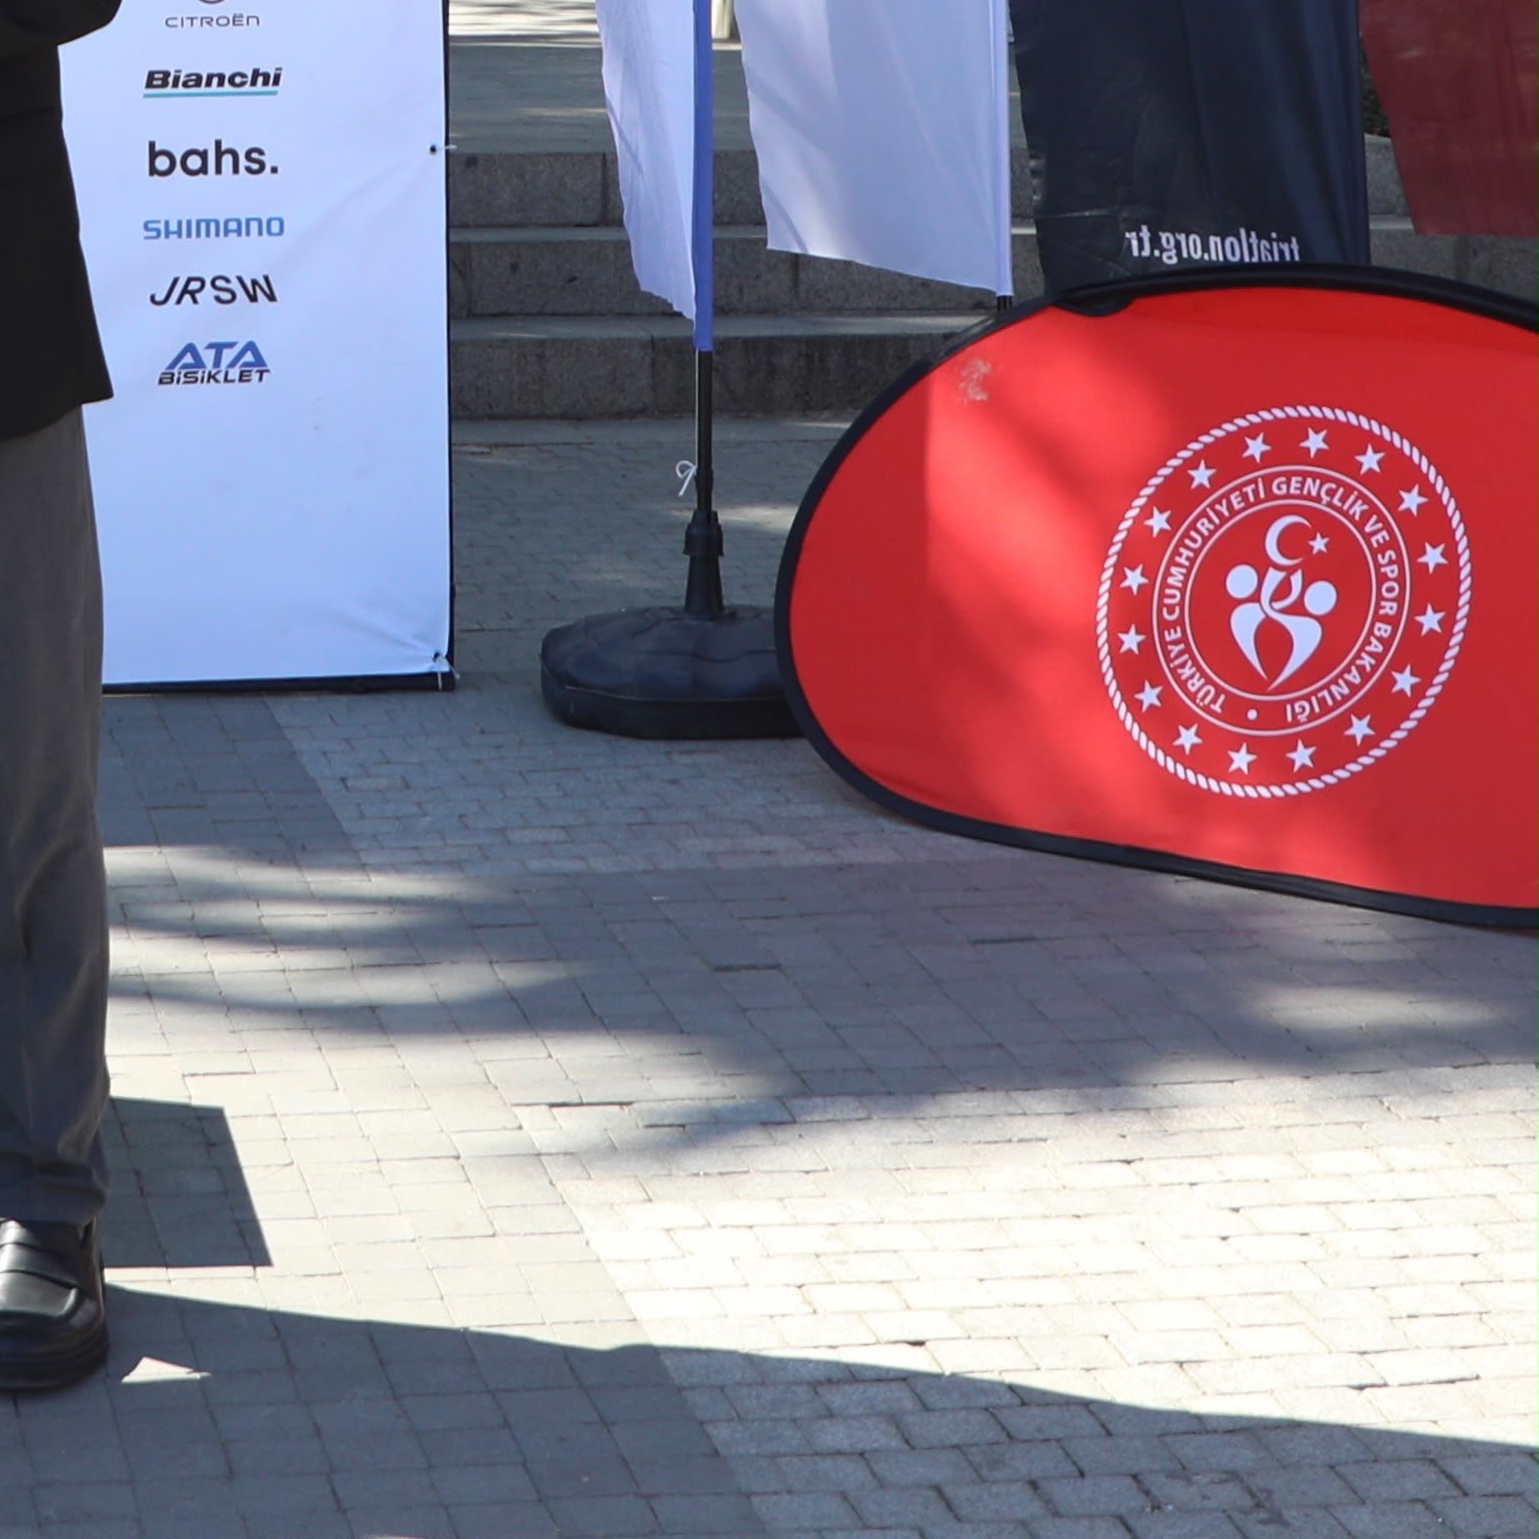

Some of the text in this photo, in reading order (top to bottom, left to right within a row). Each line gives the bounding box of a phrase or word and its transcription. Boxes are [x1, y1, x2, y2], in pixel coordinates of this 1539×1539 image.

[145, 67, 282, 90] Bianchi
[148, 140, 279, 177] bahs.
[143, 217, 285, 241] SHIMANO
[164, 340, 269, 369] ATA
[1162, 476, 1400, 723] TÜRKİYE CUMHURİYETİ GENÇLİK VE SPOR BAKANLIĞI
